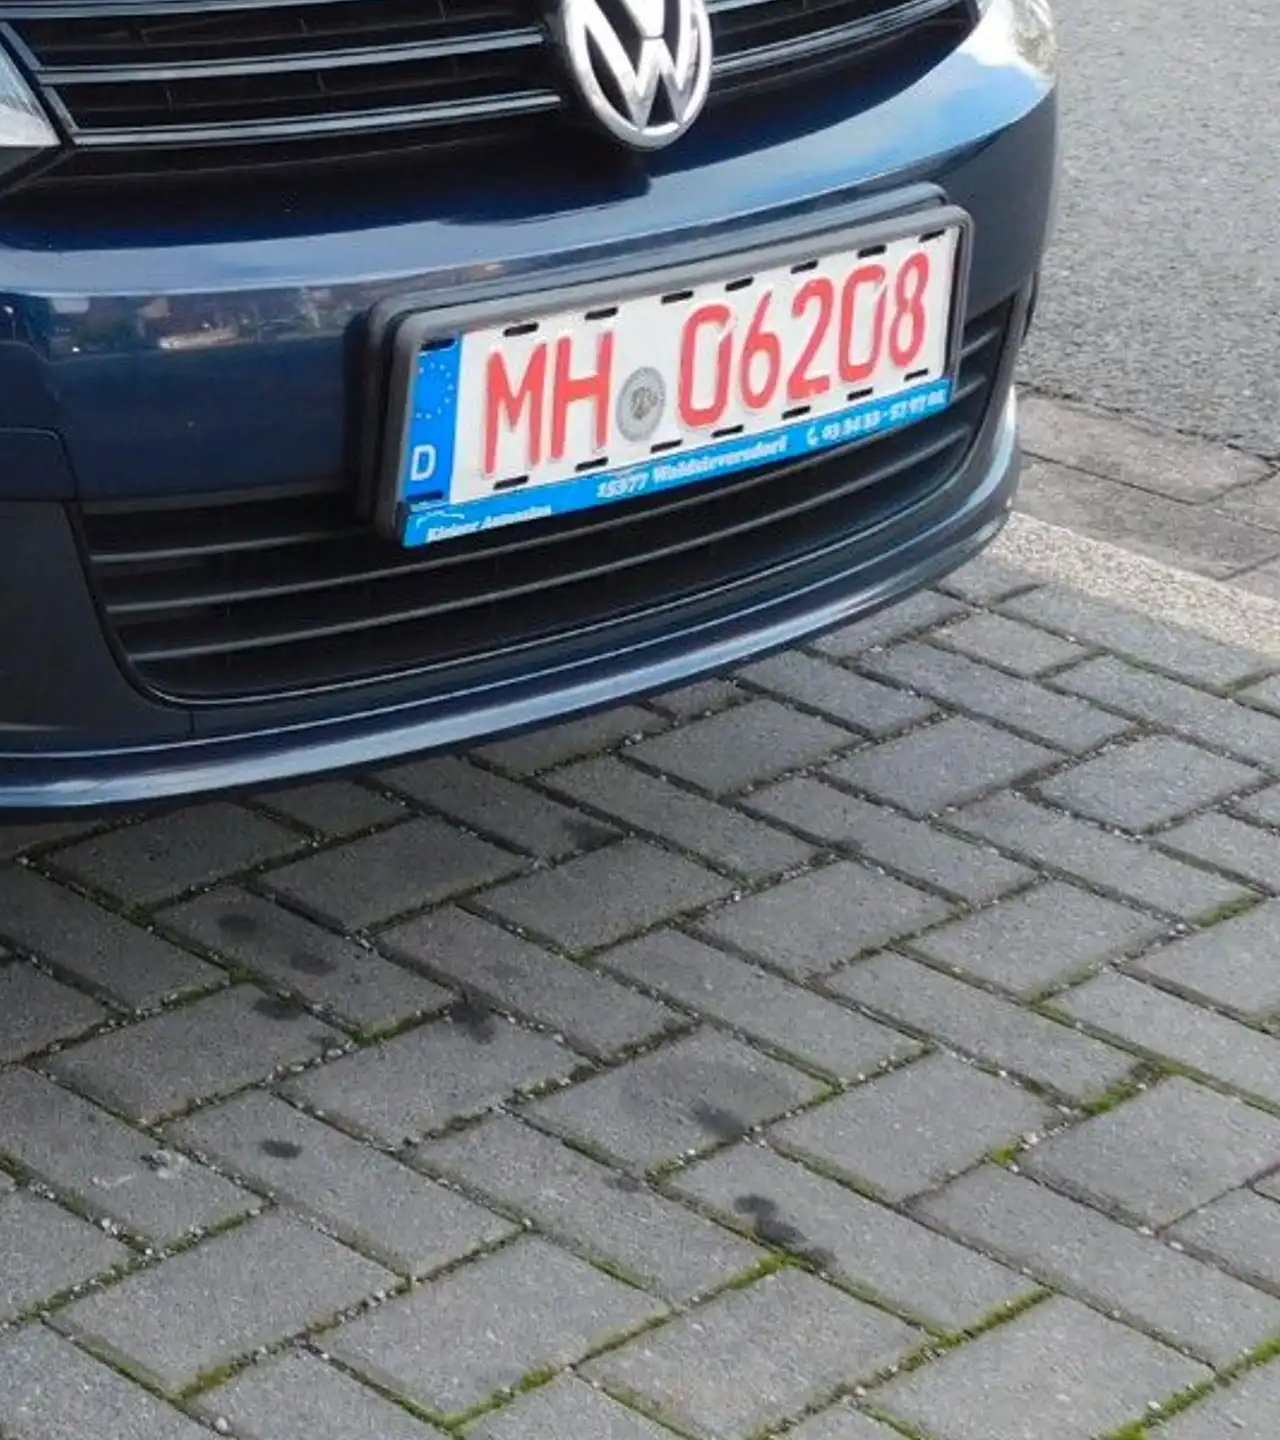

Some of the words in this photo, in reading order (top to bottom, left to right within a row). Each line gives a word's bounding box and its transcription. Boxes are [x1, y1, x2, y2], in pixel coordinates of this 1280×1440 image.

[483, 331, 614, 476] MH
[677, 251, 930, 427] 06208
[410, 444, 436, 481] D
